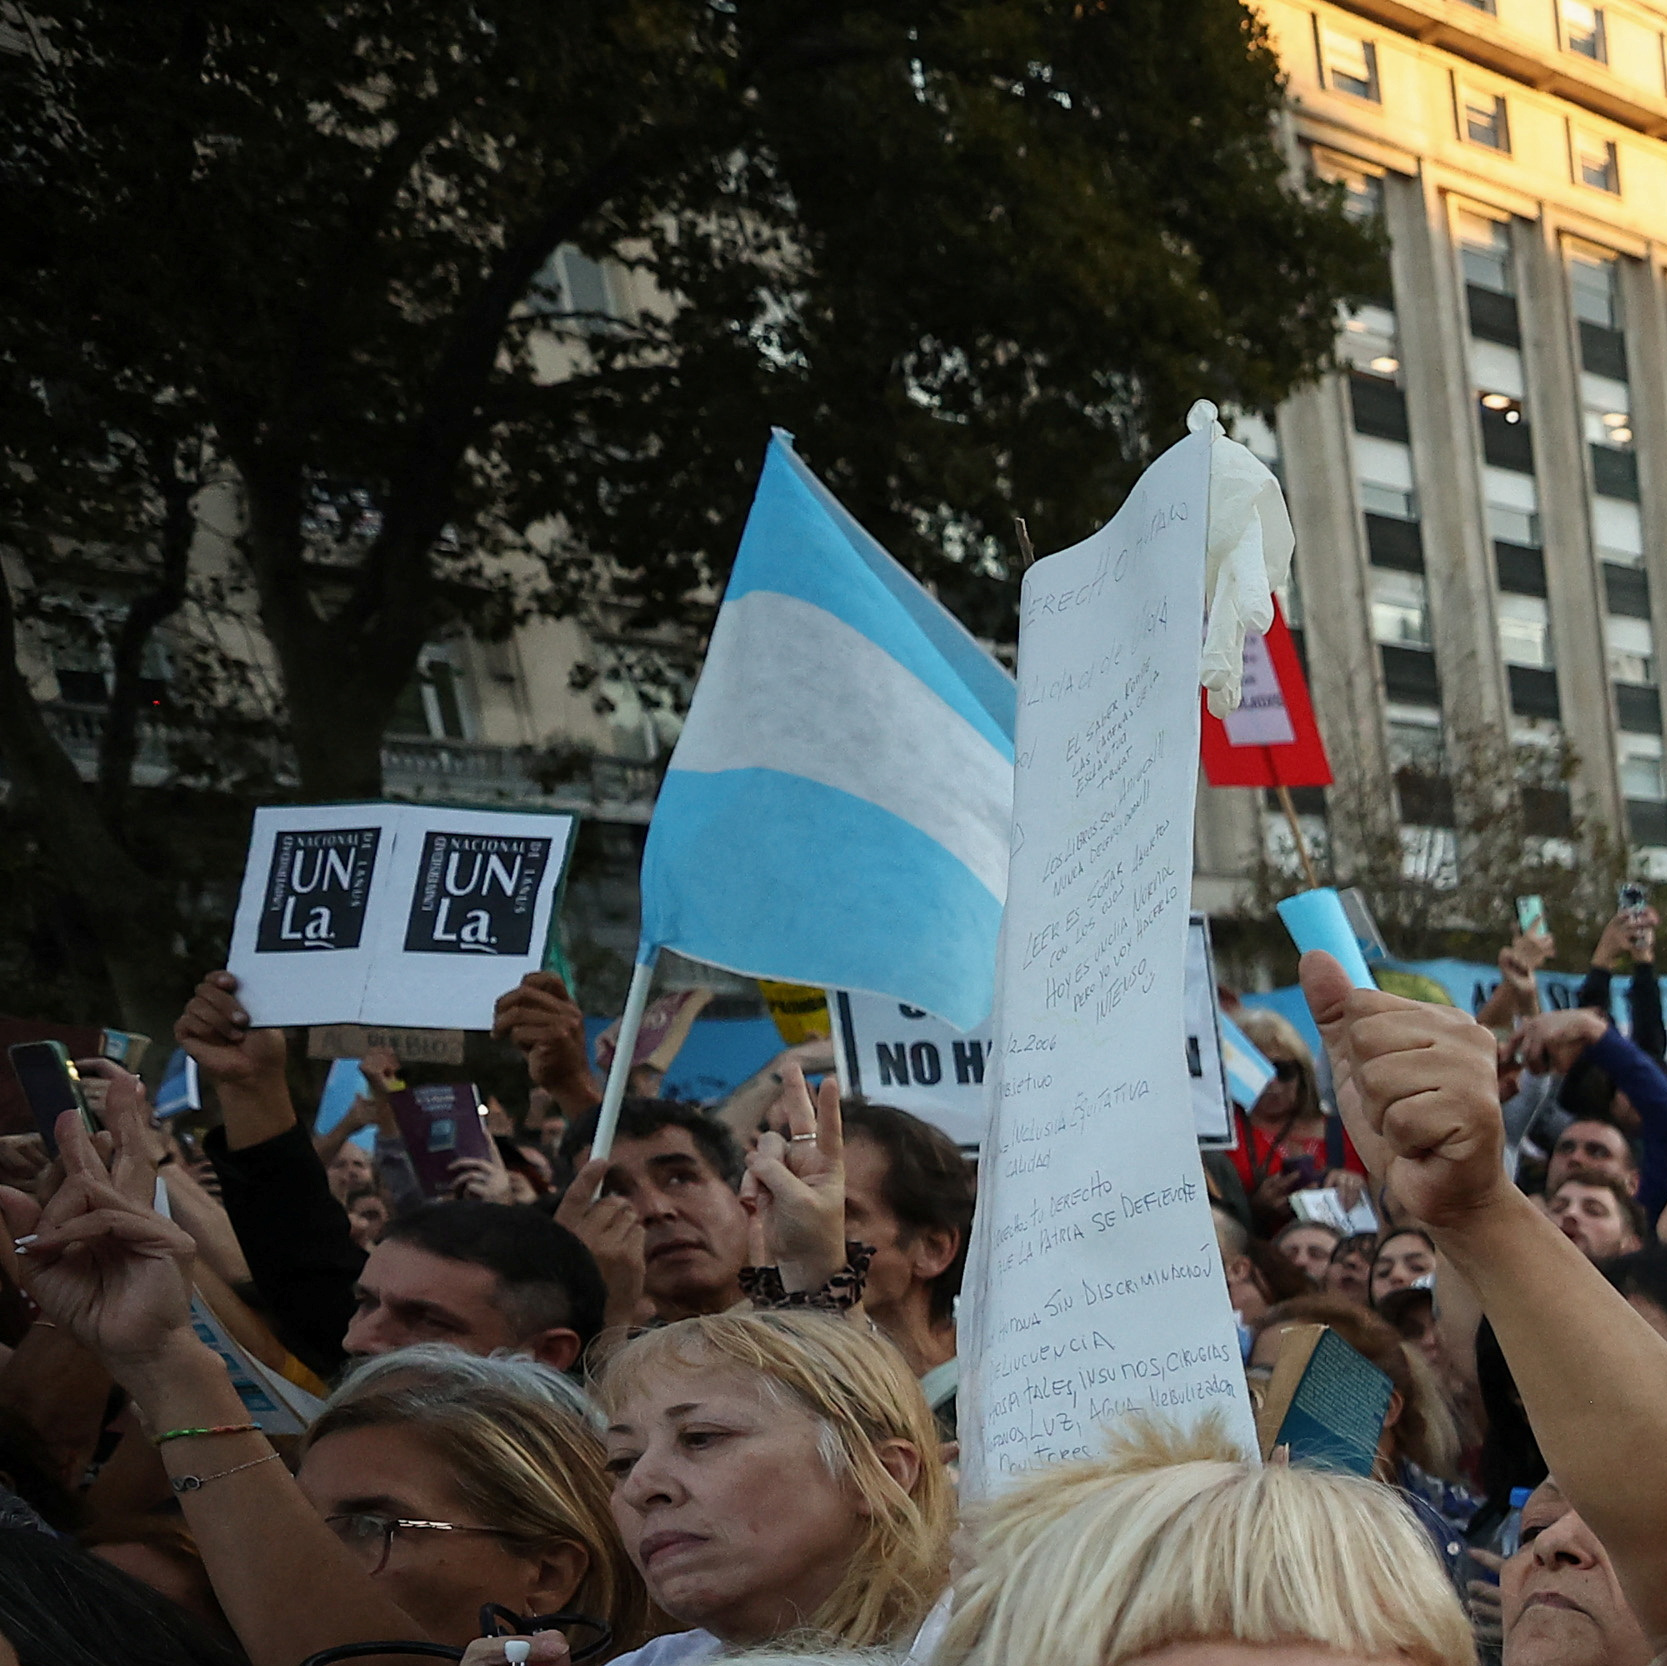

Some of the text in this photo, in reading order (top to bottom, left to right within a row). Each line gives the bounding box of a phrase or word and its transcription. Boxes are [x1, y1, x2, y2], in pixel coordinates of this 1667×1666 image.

[291, 847, 356, 894] UN
[445, 850, 522, 897] UN
[876, 1040, 942, 1087] NO
